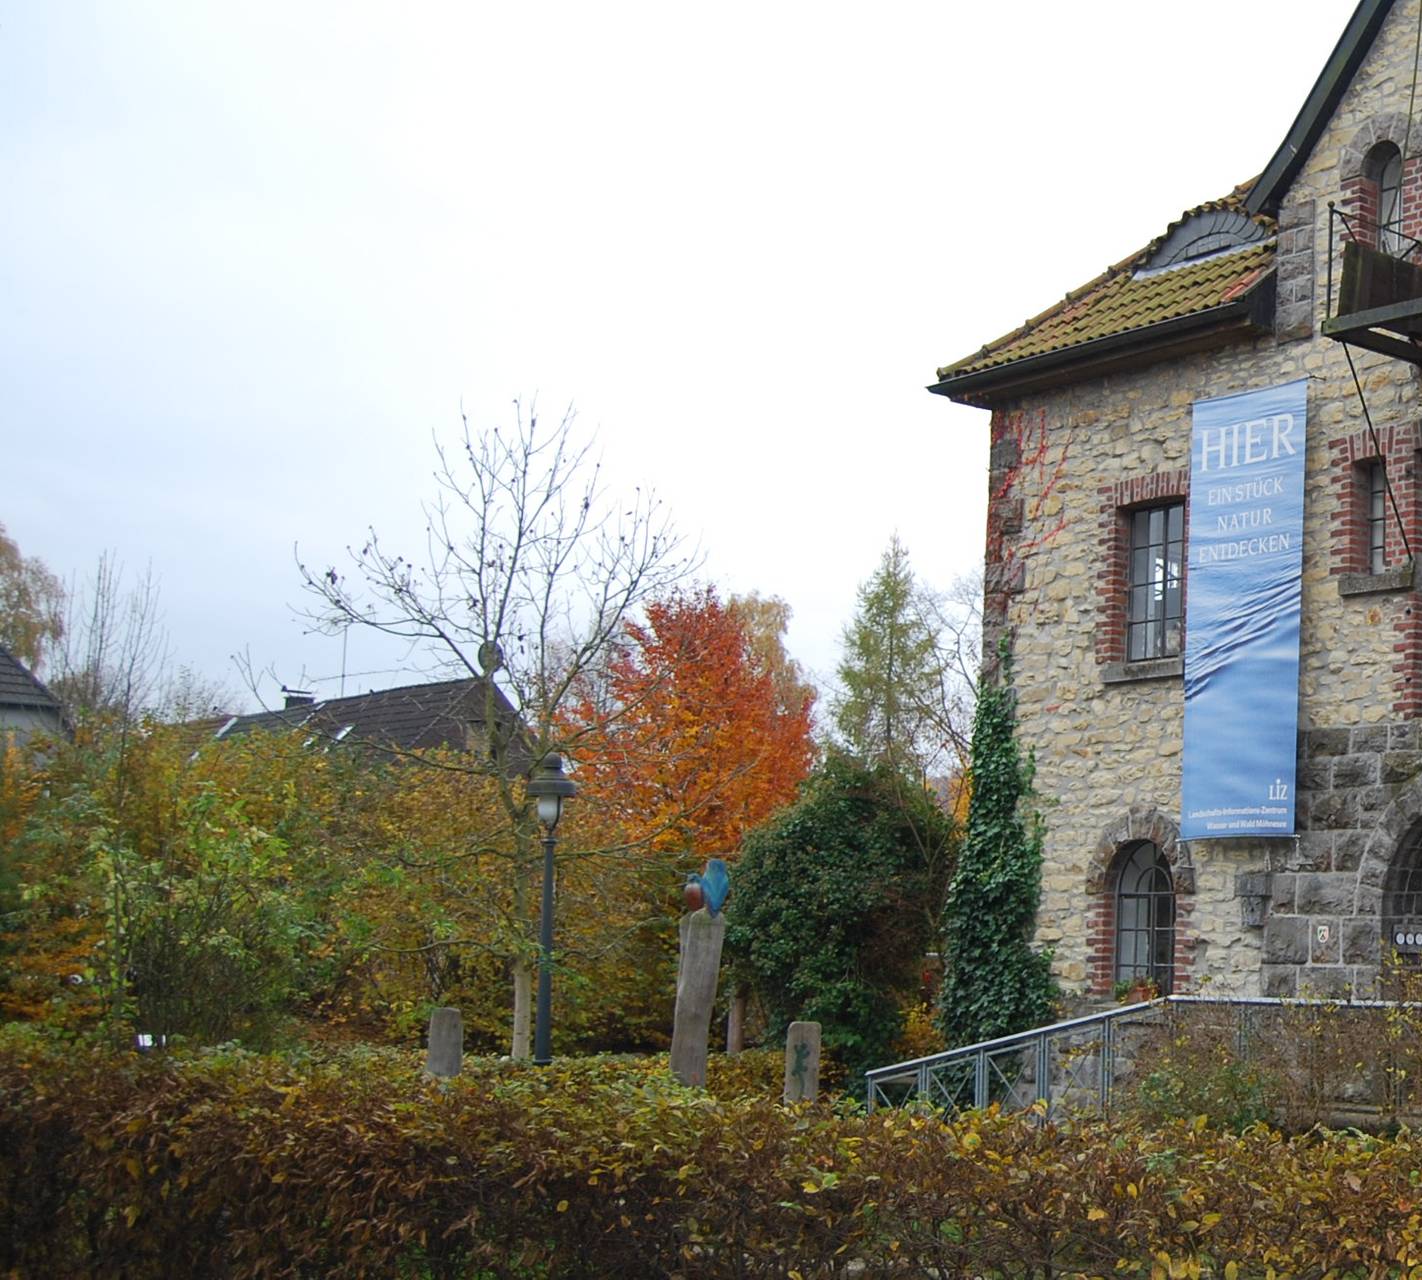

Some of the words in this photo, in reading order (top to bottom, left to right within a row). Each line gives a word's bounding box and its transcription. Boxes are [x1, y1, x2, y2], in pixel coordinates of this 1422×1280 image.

[1201, 413, 1297, 473] HIER
[1208, 487, 1232, 506] EIN
[1235, 475, 1284, 502] STÜCK
[1217, 508, 1272, 533] NATUR
[1199, 533, 1290, 563] ENTDECKEN
